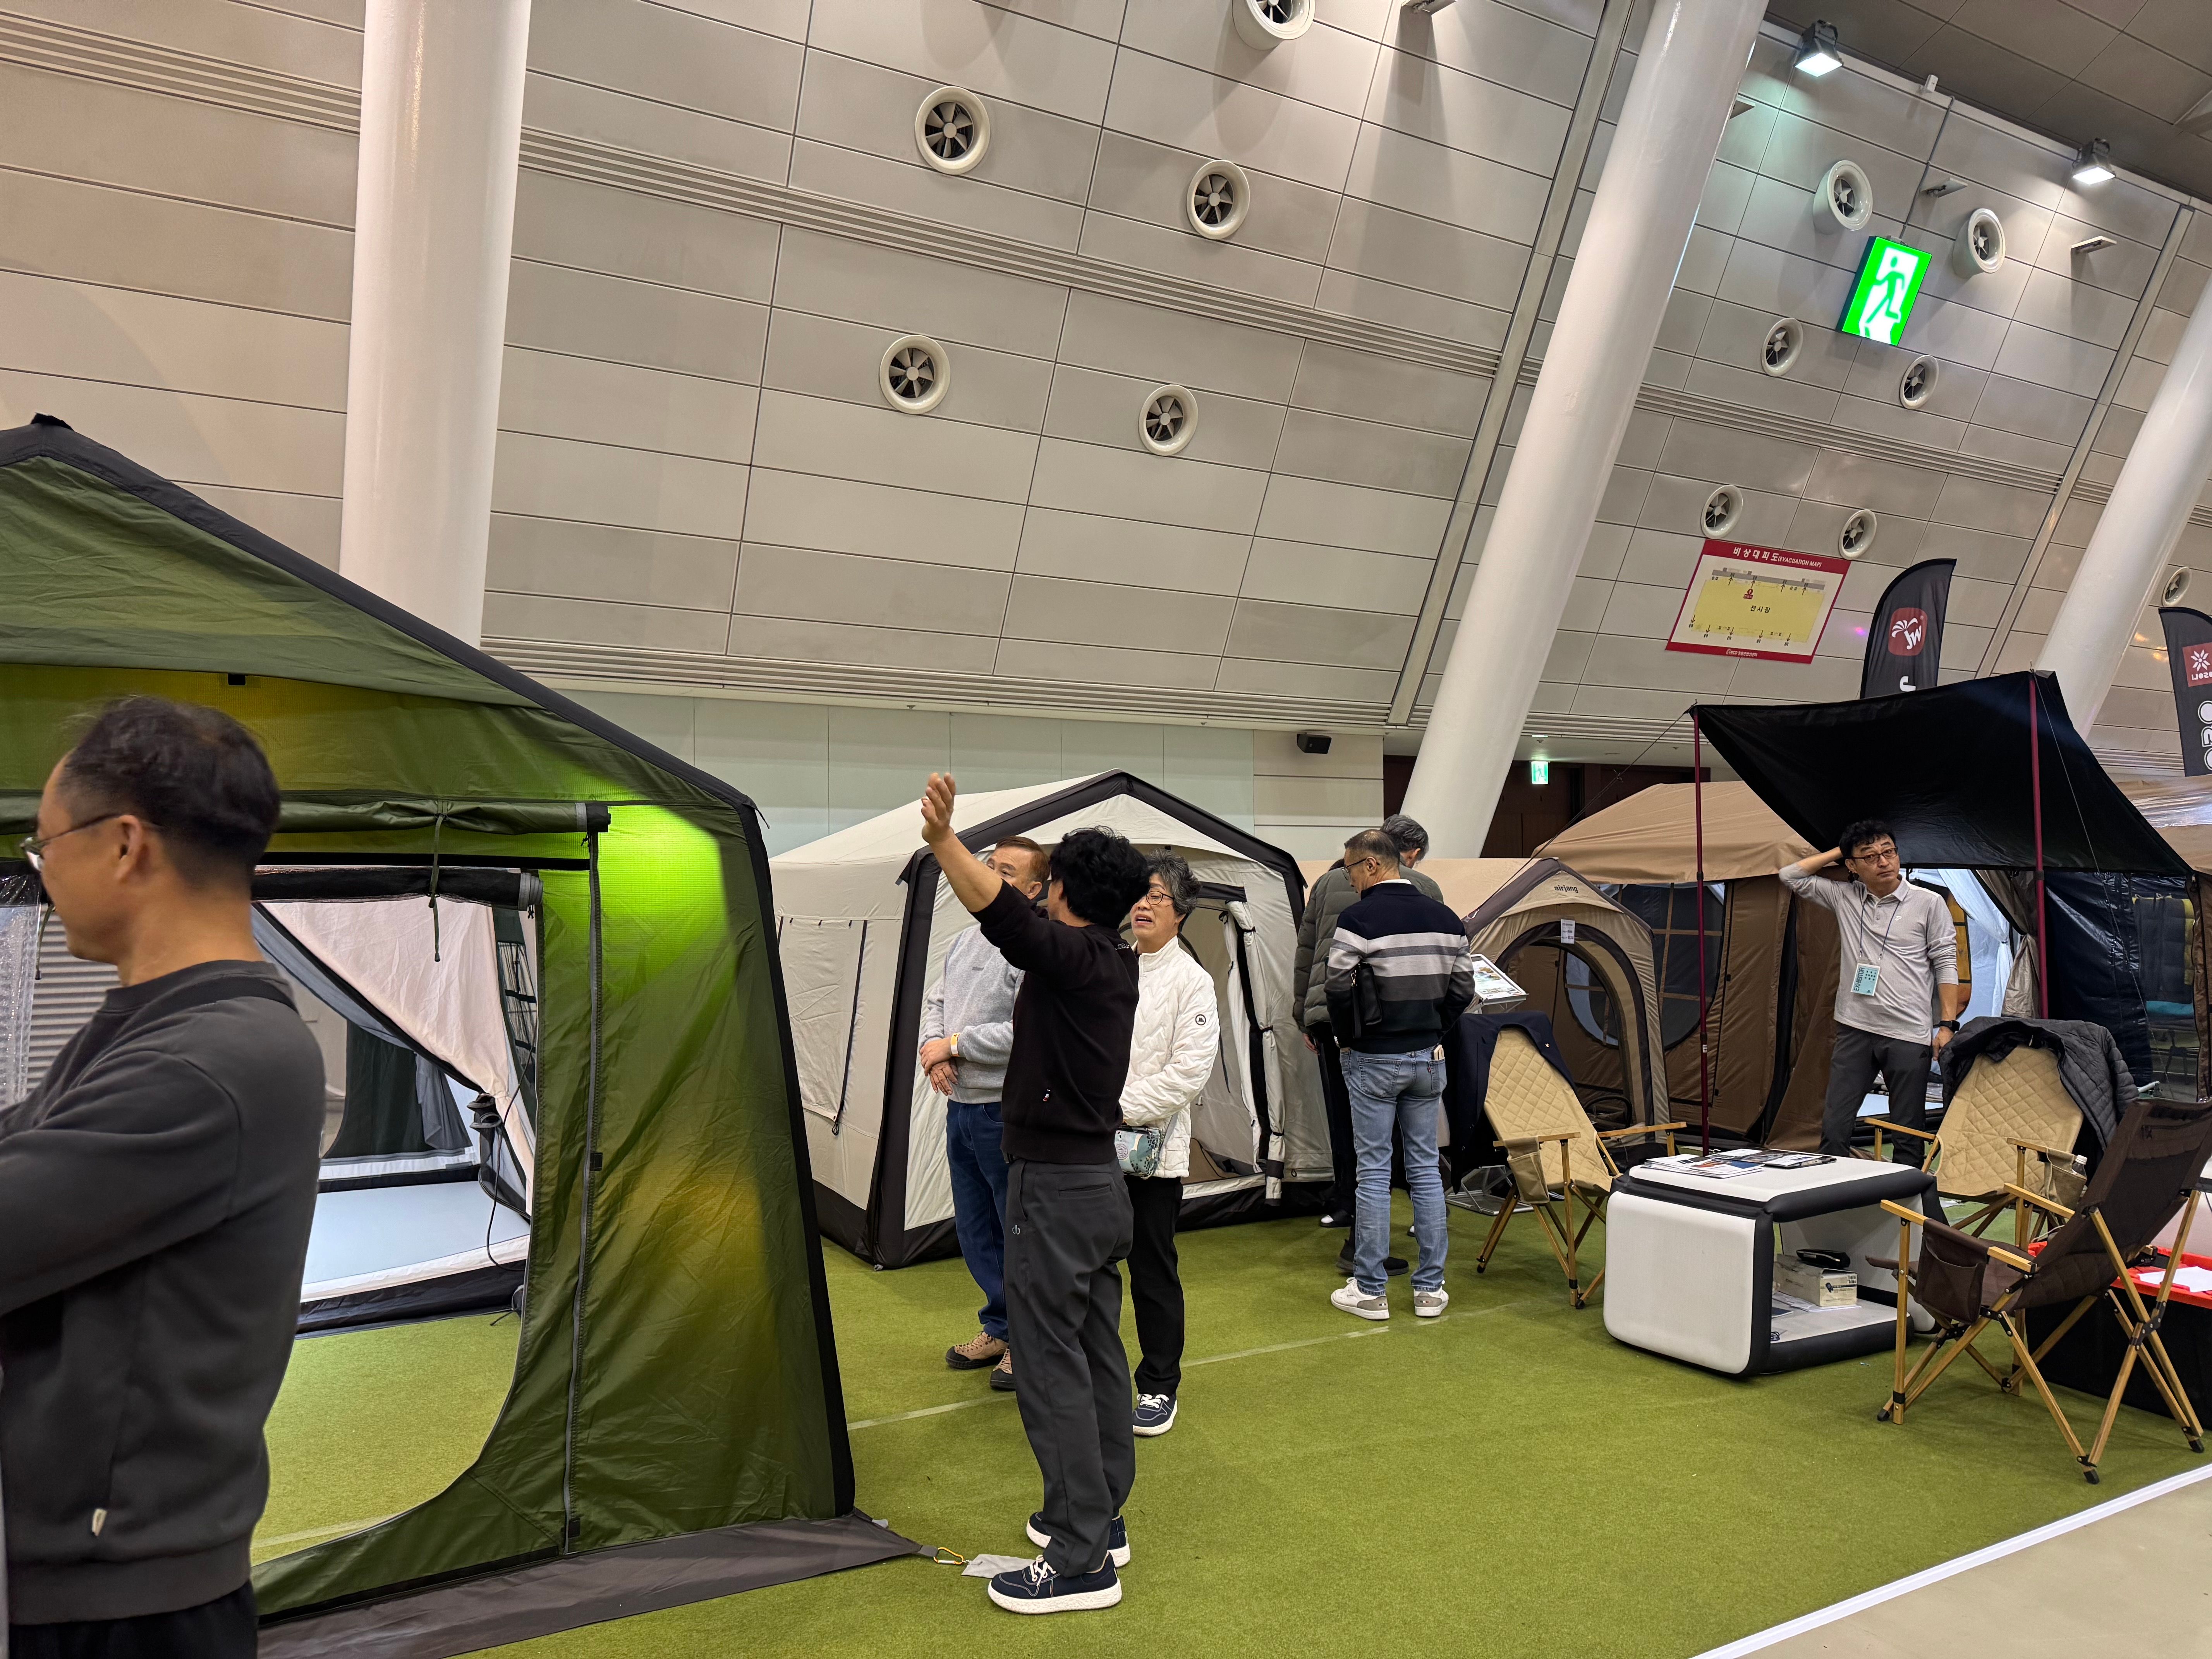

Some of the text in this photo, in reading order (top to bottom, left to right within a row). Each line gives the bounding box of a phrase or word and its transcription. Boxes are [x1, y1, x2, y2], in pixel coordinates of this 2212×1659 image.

[1750, 605, 1771, 613] 전시장
[1554, 885, 1579, 893] airjang
[1853, 967, 1865, 991] EXHIBITOR
